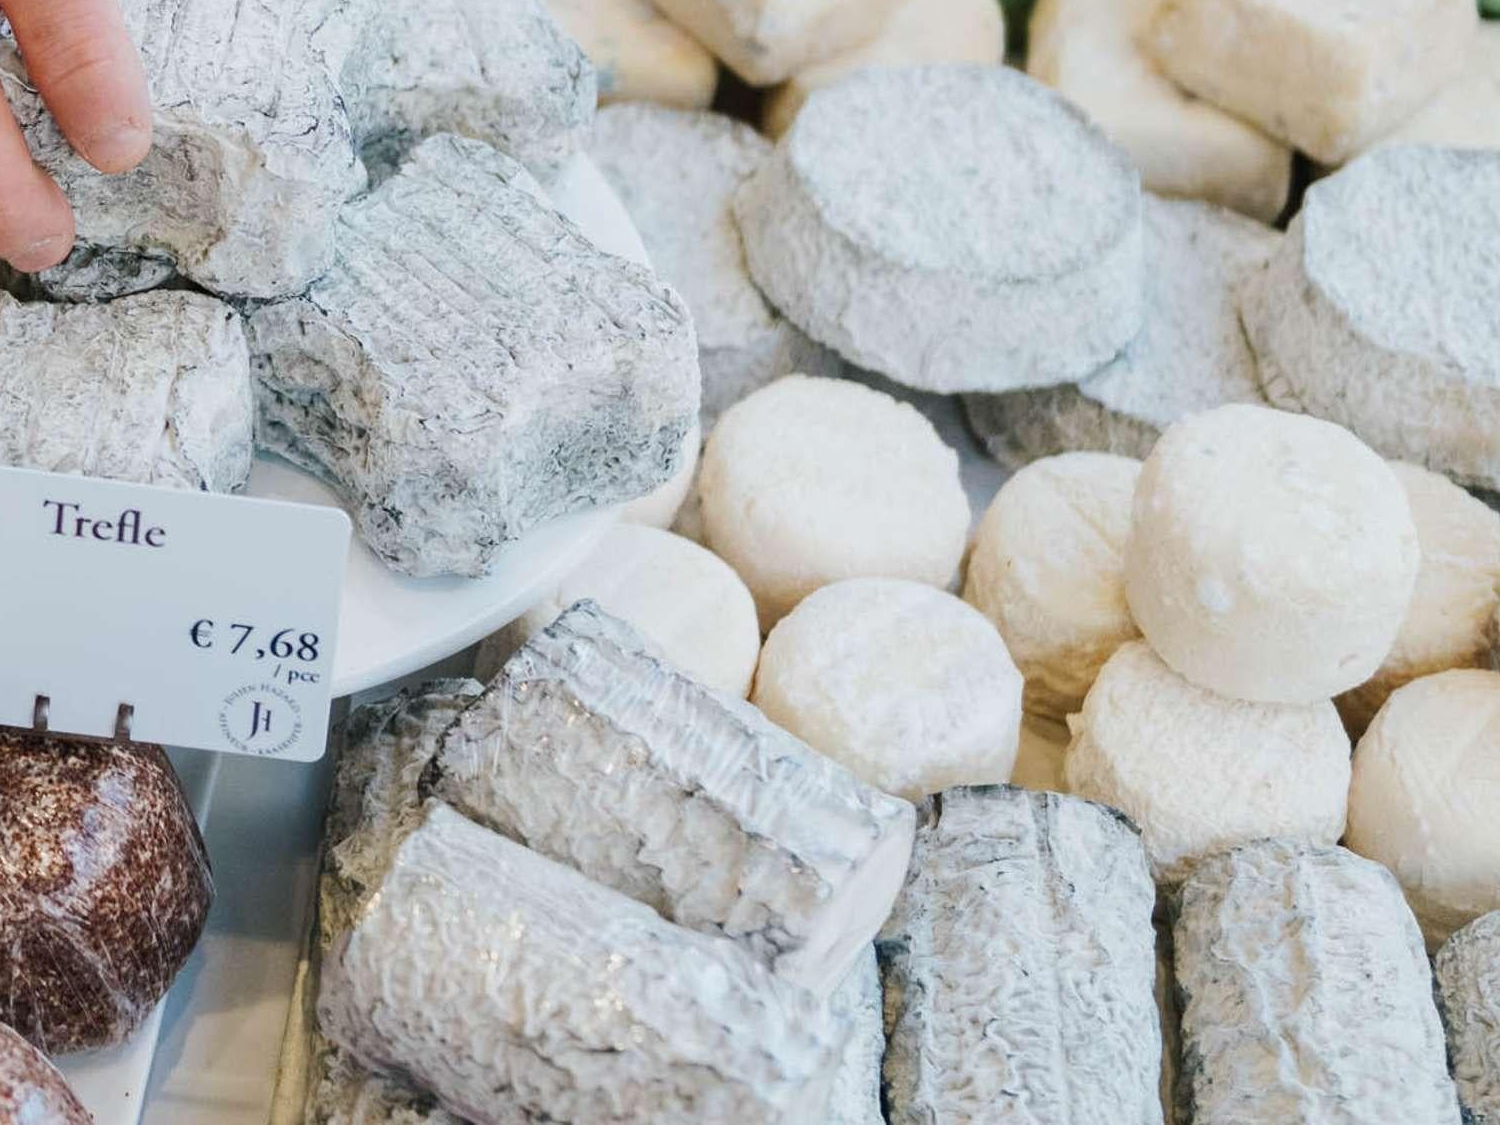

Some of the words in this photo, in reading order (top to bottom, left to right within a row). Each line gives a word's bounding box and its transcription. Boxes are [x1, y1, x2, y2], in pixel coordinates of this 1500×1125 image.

[43, 499, 167, 548] Trefle
[190, 619, 214, 648] €
[230, 623, 320, 662] 7,68
